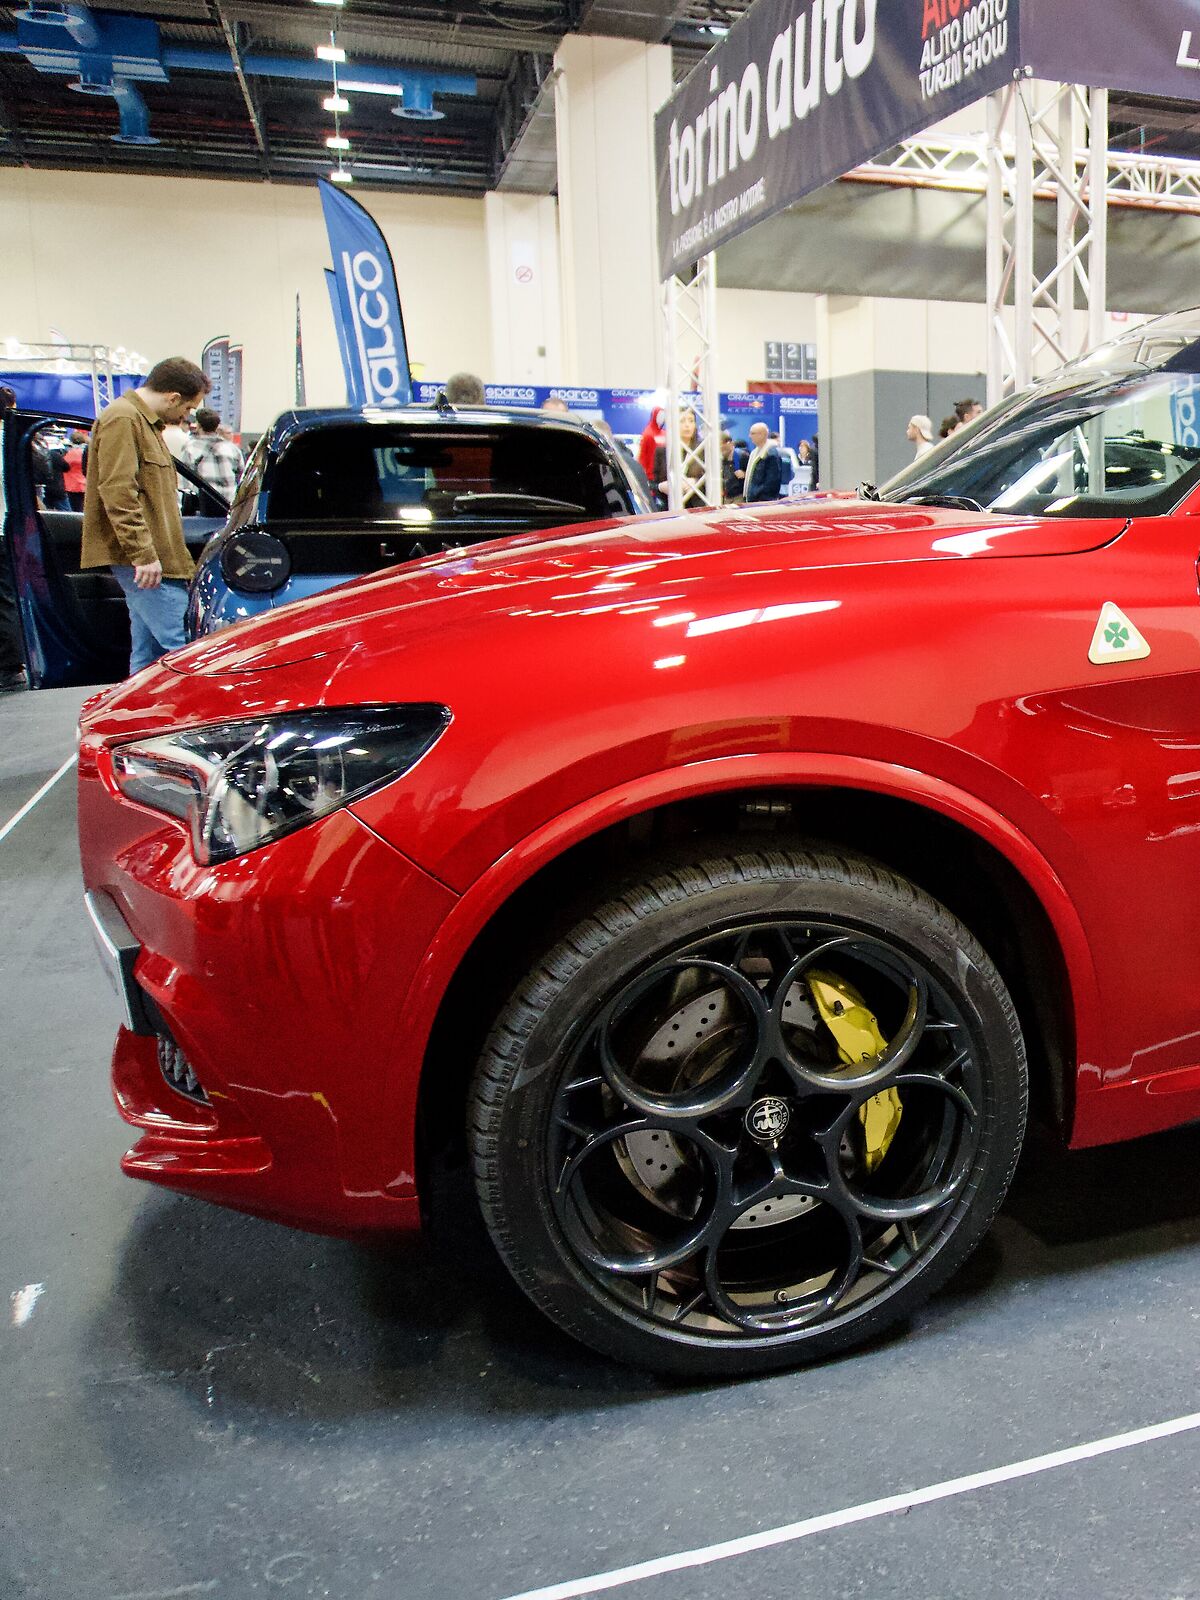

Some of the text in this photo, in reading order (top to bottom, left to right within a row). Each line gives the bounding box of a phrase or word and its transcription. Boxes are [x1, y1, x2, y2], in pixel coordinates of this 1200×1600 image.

[920, 19, 961, 71] AUTO
[963, 0, 1008, 43] MOTO
[919, 50, 961, 100] TURIN
[963, 20, 1008, 76] SHOW
[668, 0, 878, 215] torino auto
[768, 342, 778, 357] 1
[787, 343, 798, 358] 2
[485, 387, 535, 399] sparco
[727, 394, 764, 402] ORACLE
